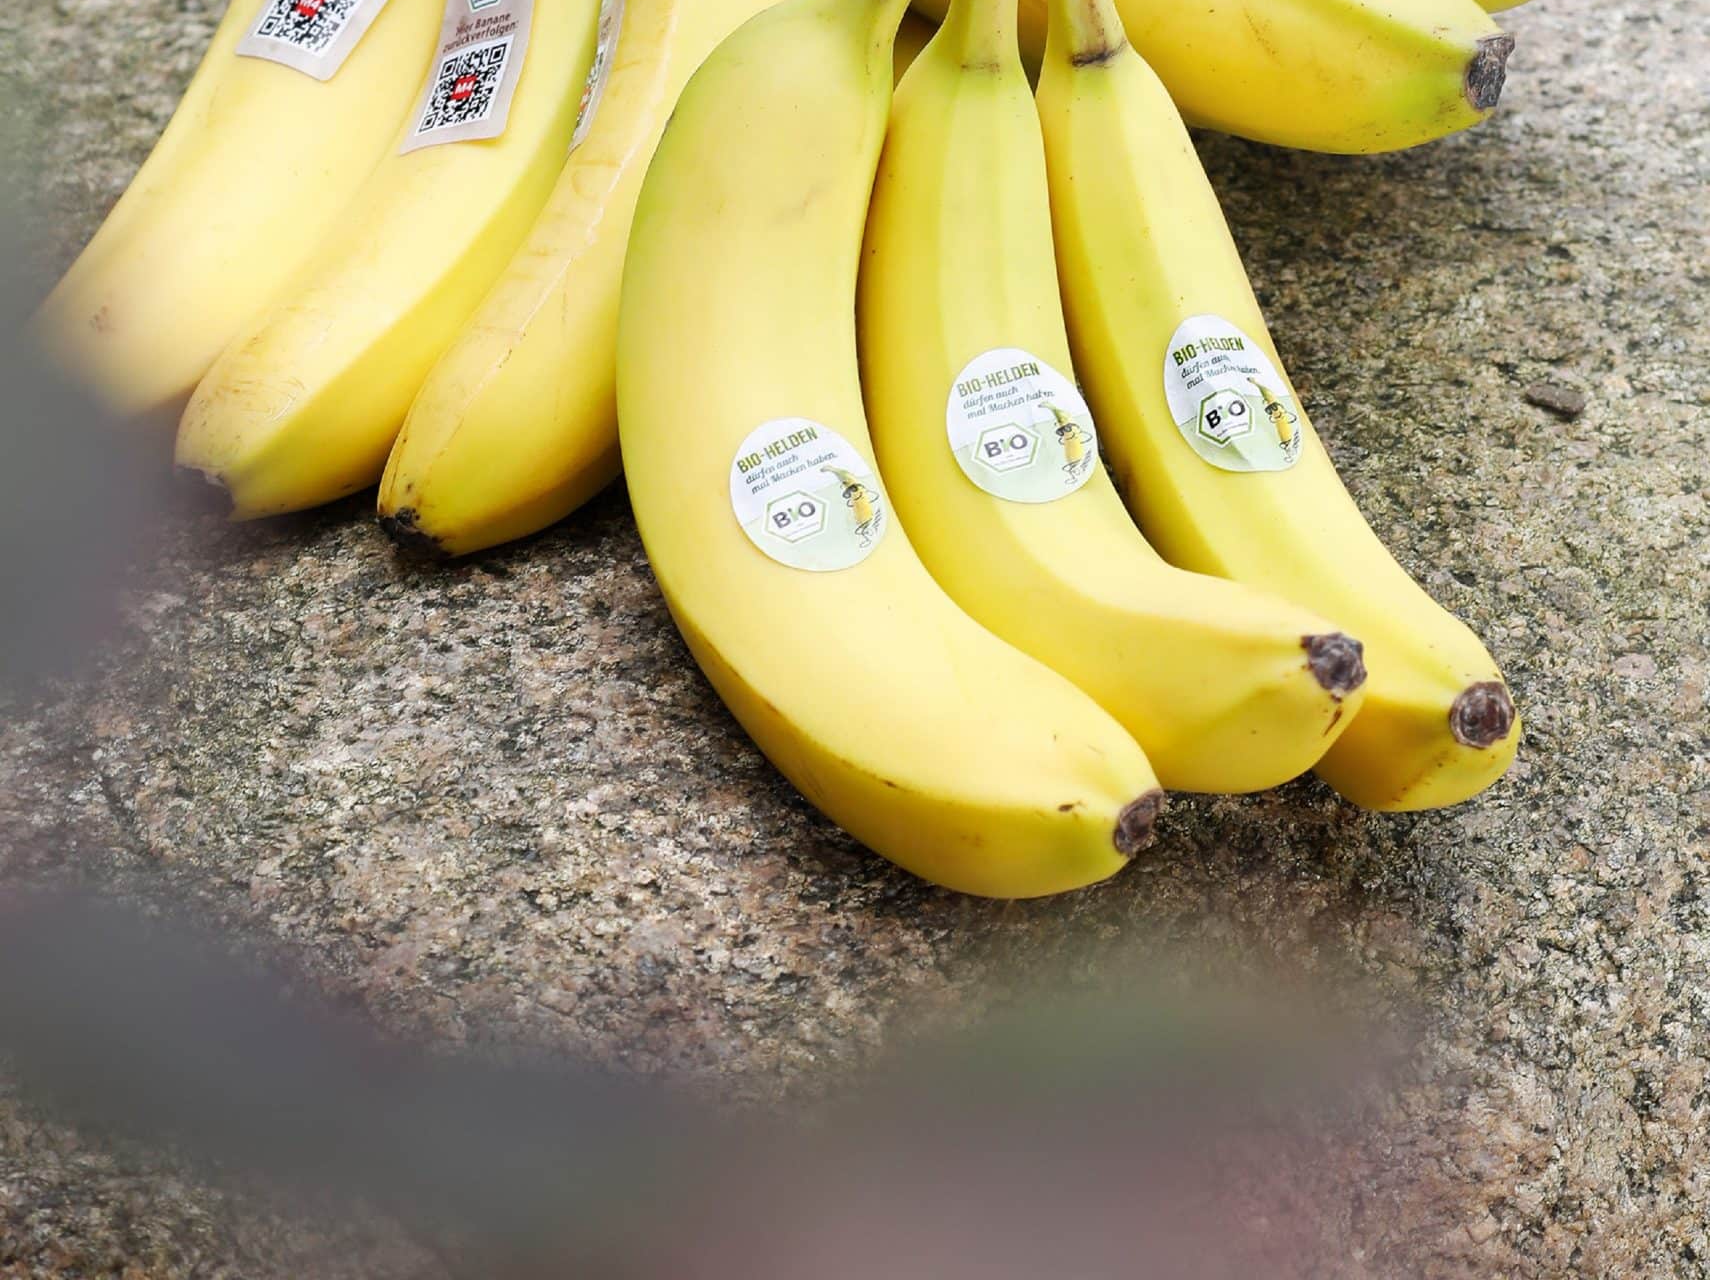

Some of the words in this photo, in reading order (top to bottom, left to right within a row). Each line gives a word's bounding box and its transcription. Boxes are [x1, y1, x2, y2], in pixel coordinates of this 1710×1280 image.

[475, 12, 511, 30] Banane
[1172, 336, 1245, 366] BIO-HELDEN
[957, 362, 1040, 398] BIO-HELDEN
[995, 385, 1019, 400] auch
[1186, 374, 1204, 390] mal
[967, 406, 987, 419] mal
[987, 396, 1025, 412] Macken
[1205, 399, 1246, 429] BIO
[736, 426, 819, 474] BIO-HELDEN
[983, 433, 1028, 458] BIO
[776, 454, 799, 471] auch
[751, 480, 770, 495] mal
[770, 464, 806, 484] Macken
[772, 501, 816, 529] BIO
